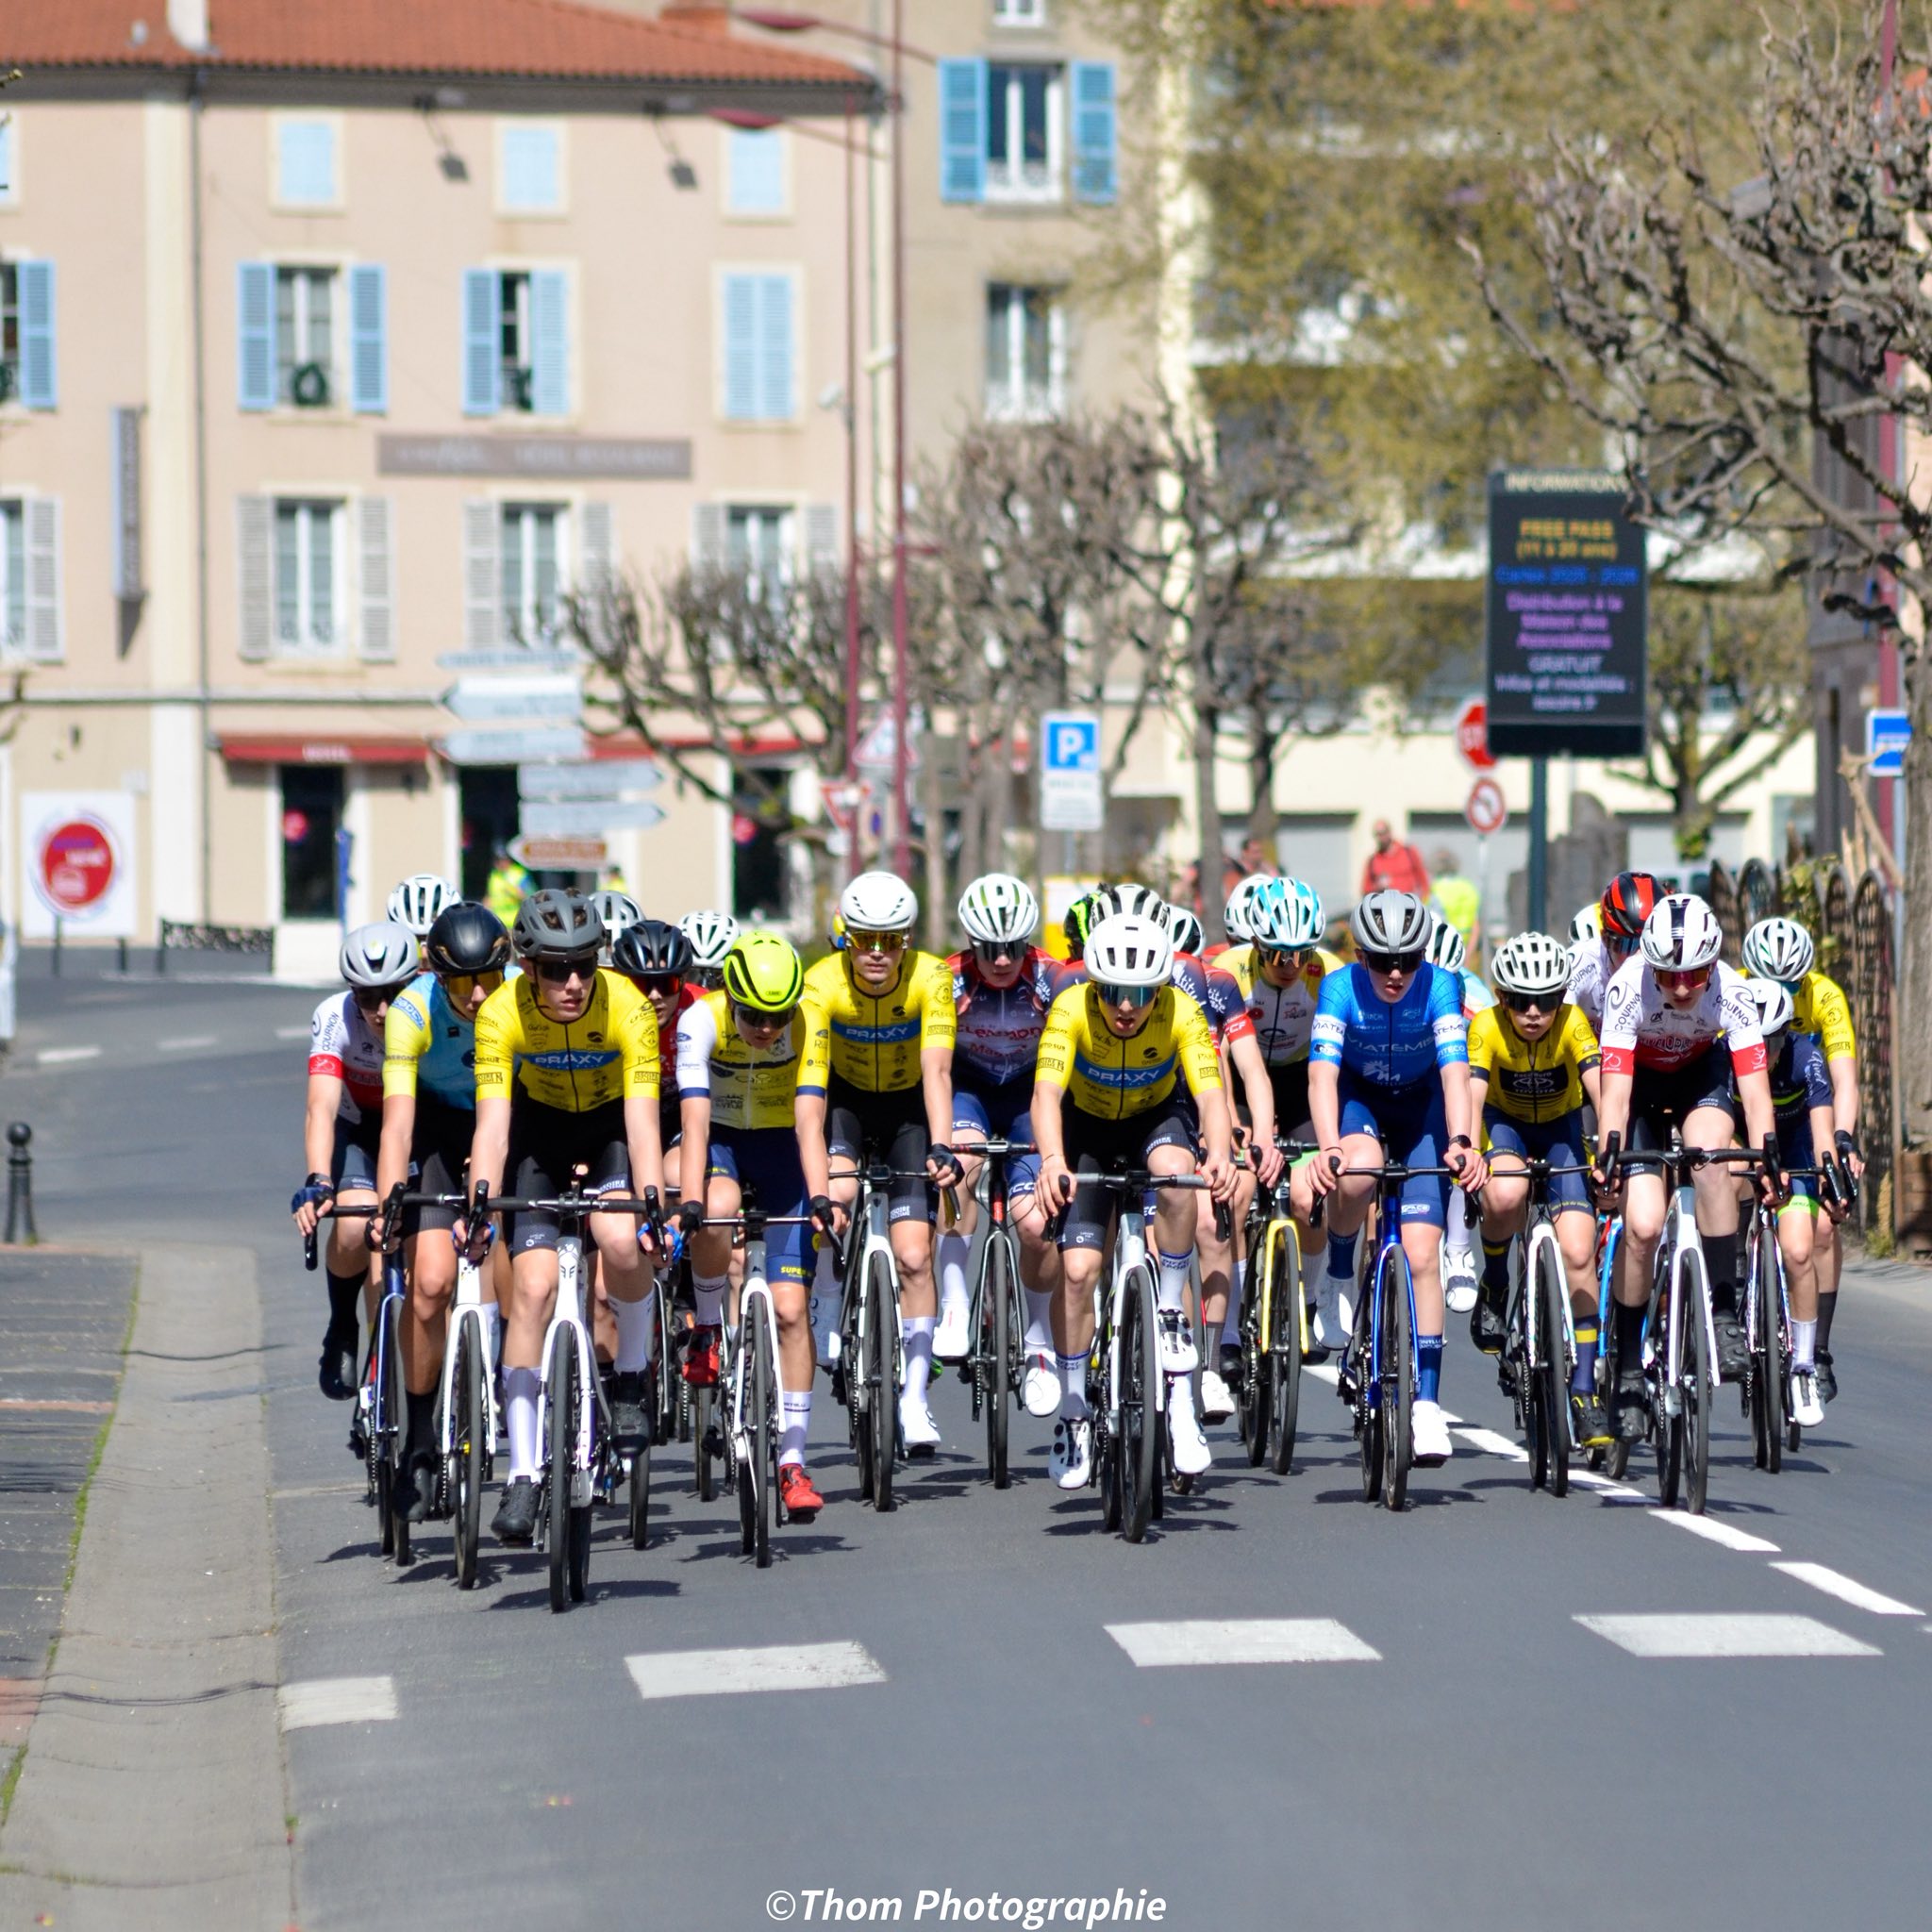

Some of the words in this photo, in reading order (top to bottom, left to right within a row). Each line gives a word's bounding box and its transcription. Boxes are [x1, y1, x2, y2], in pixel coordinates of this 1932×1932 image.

[1520, 520, 1565, 538] FREE
[1569, 520, 1614, 539] PASS
[1507, 592, 1591, 611] Distribution
[1527, 654, 1603, 674] GRATUIT
[1057, 726, 1086, 765] P
[1614, 992, 1642, 1032] COURNO
[844, 1025, 908, 1040] PRAXY
[534, 1054, 605, 1065] PRAXY
[1087, 1067, 1160, 1084] PRAXY
